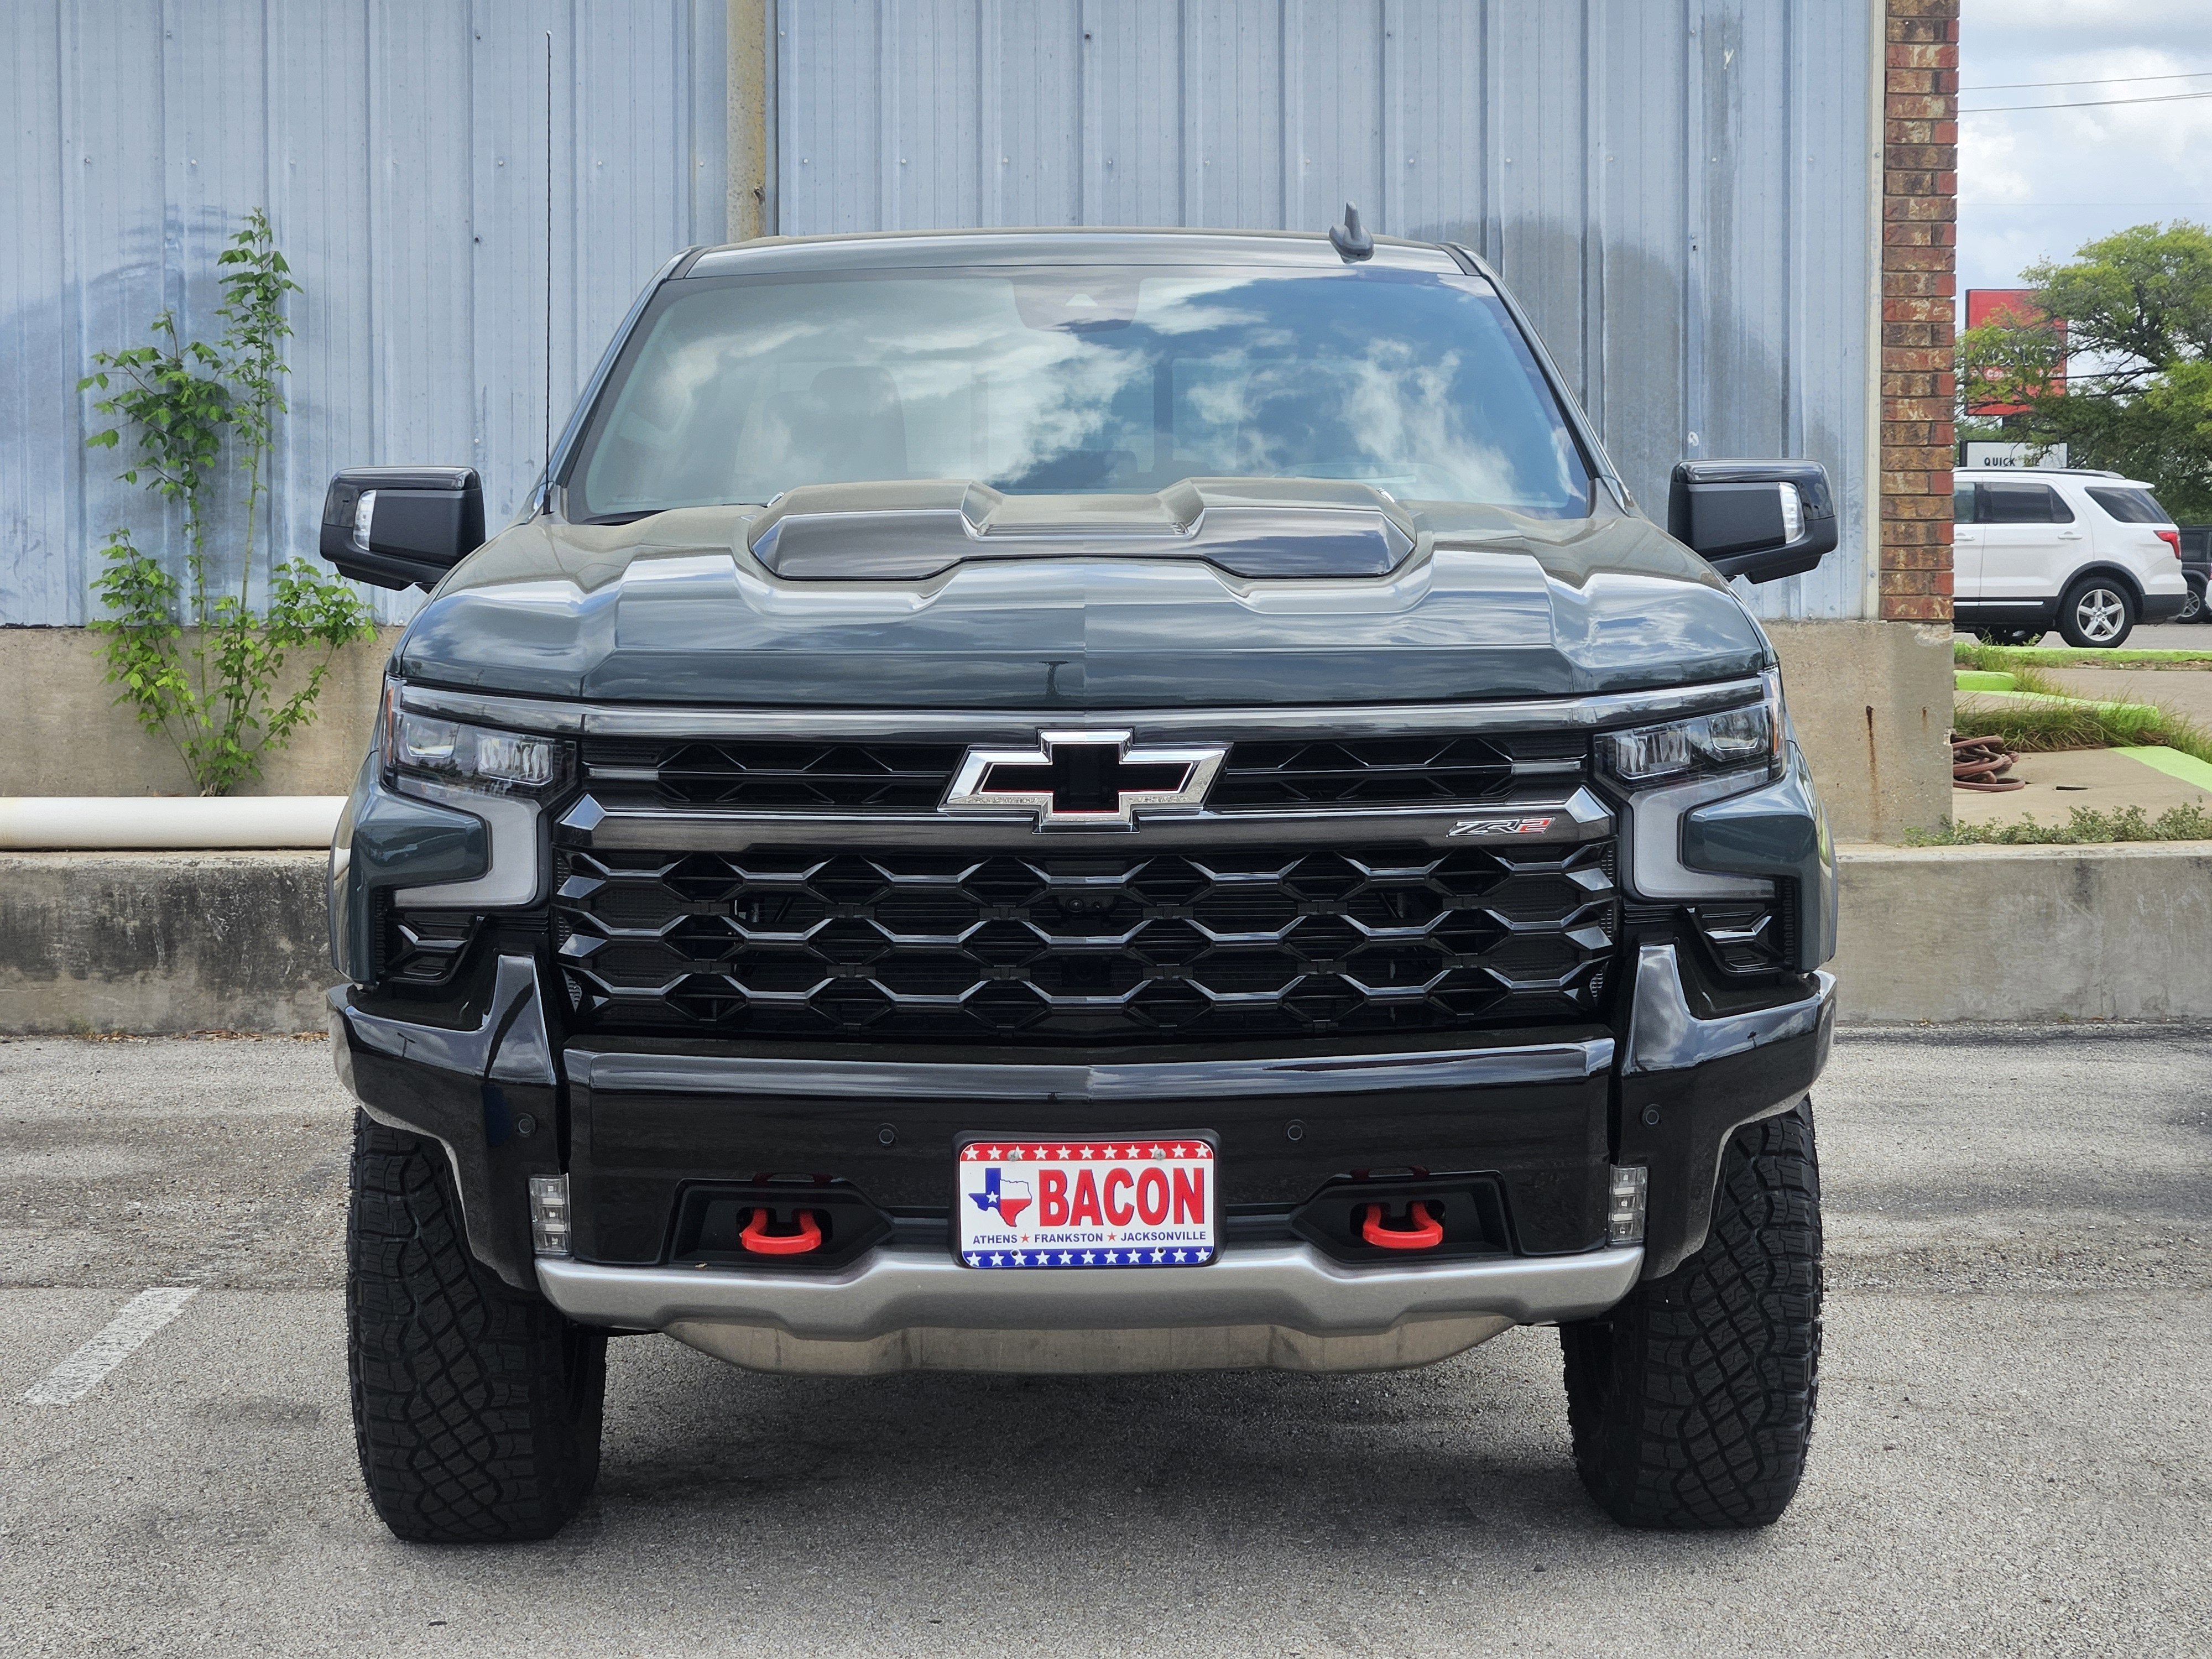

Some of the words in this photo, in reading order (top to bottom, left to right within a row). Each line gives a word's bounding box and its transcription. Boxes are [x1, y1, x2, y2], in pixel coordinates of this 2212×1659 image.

[1984, 457, 2016, 467] QUICK
[1446, 817, 1556, 837] ZR2
[1039, 1167, 1205, 1227] BACON
[973, 1234, 1018, 1244] ATHENS
[1034, 1232, 1103, 1243] FRANKSTON
[1120, 1230, 1207, 1241] JACKSONVILLE
